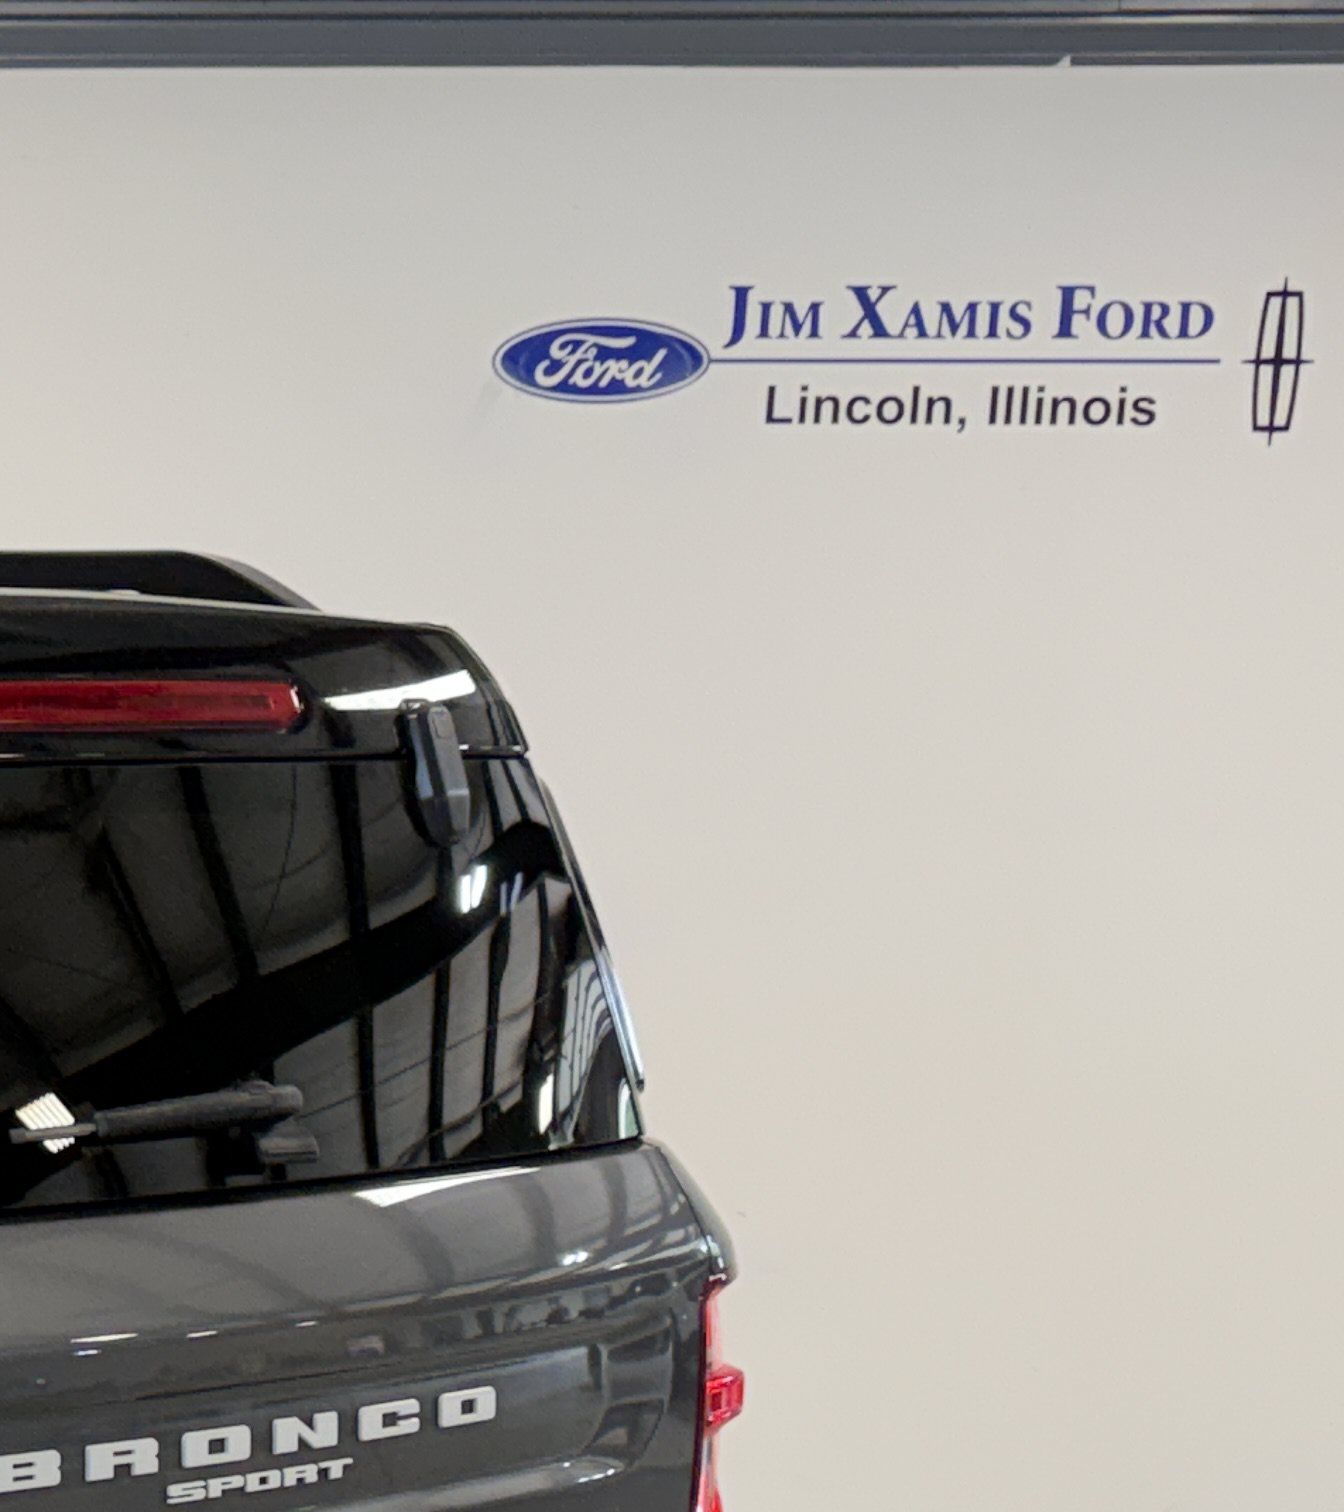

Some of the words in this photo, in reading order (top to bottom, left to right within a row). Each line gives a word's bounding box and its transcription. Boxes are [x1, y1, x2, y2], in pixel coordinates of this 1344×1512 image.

[722, 285, 825, 349] JIM
[840, 285, 1034, 340] XAMIS
[1051, 285, 1216, 340] FORD
[534, 332, 666, 389] Ford
[765, 385, 968, 433] Lincoln,
[988, 386, 1158, 426] Illinois
[166, 1457, 354, 1504] SPORT
